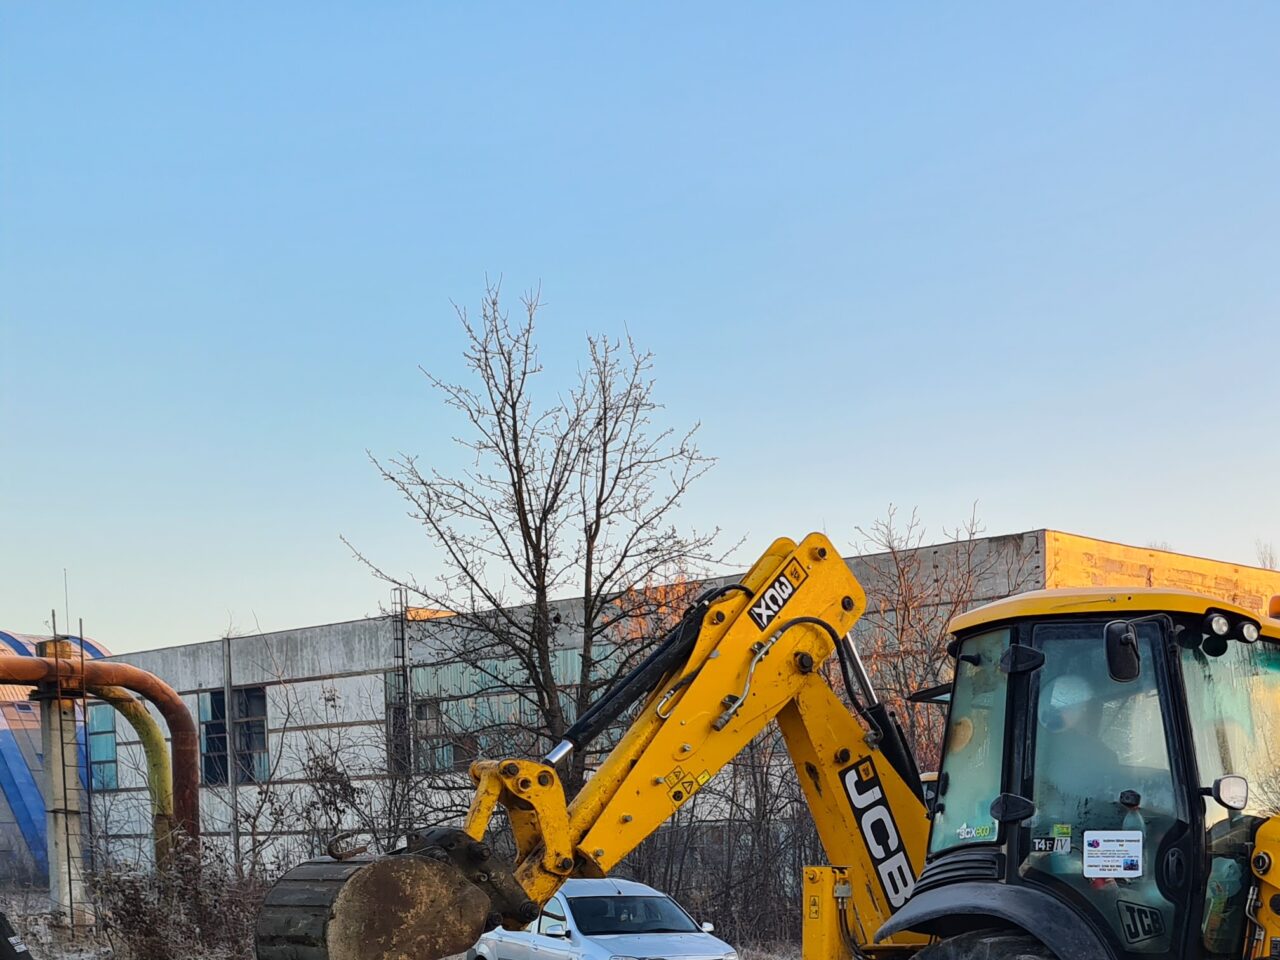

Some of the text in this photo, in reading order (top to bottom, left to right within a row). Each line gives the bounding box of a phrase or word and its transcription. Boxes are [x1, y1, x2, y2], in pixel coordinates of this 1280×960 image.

[751, 576, 793, 626] 3CX
[845, 769, 915, 908] JCB
[1125, 905, 1162, 939] JCB
